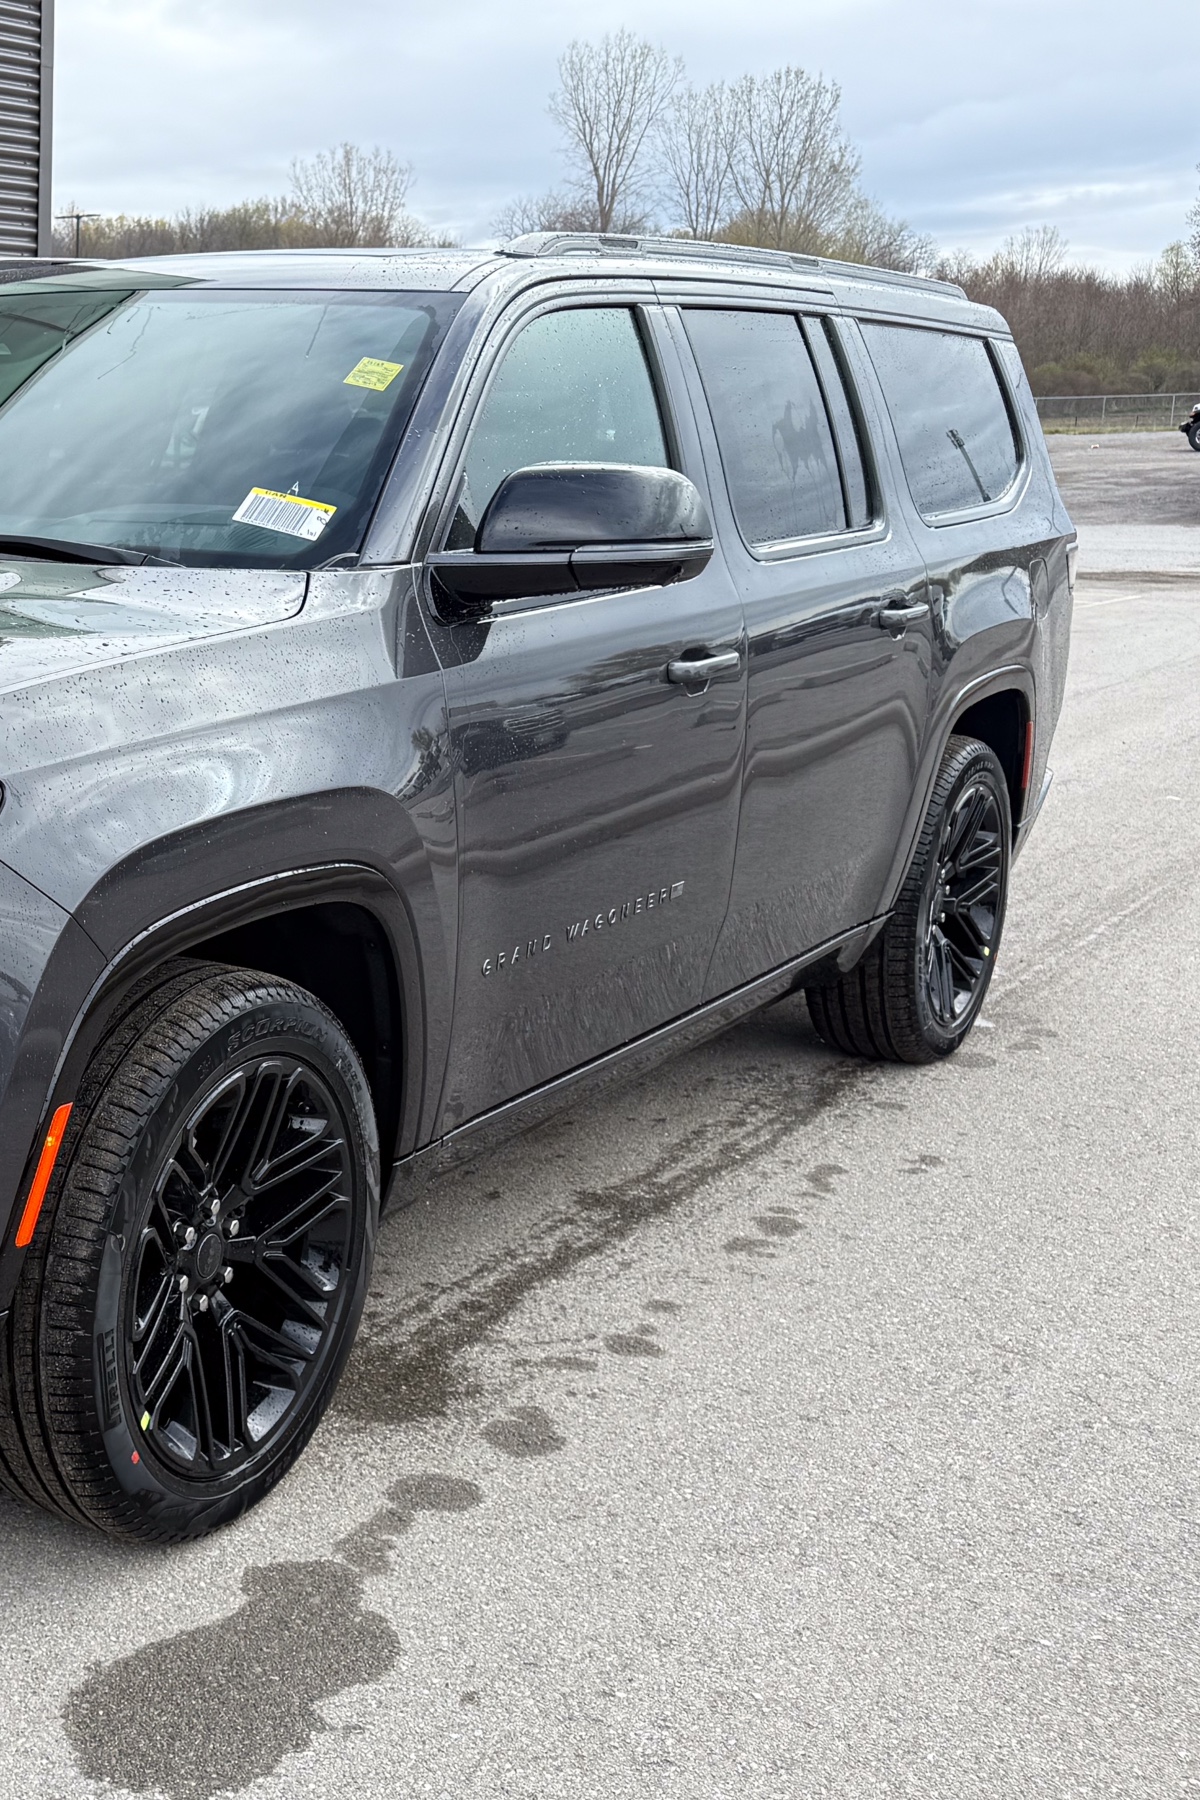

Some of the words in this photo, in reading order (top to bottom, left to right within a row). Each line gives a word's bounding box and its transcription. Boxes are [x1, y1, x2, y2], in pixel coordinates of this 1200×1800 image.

[481, 934, 552, 977] GRAND
[565, 887, 668, 943] WAGONEER
[228, 1017, 328, 1051] SCORPION
[97, 1328, 122, 1432] PIRELLI
